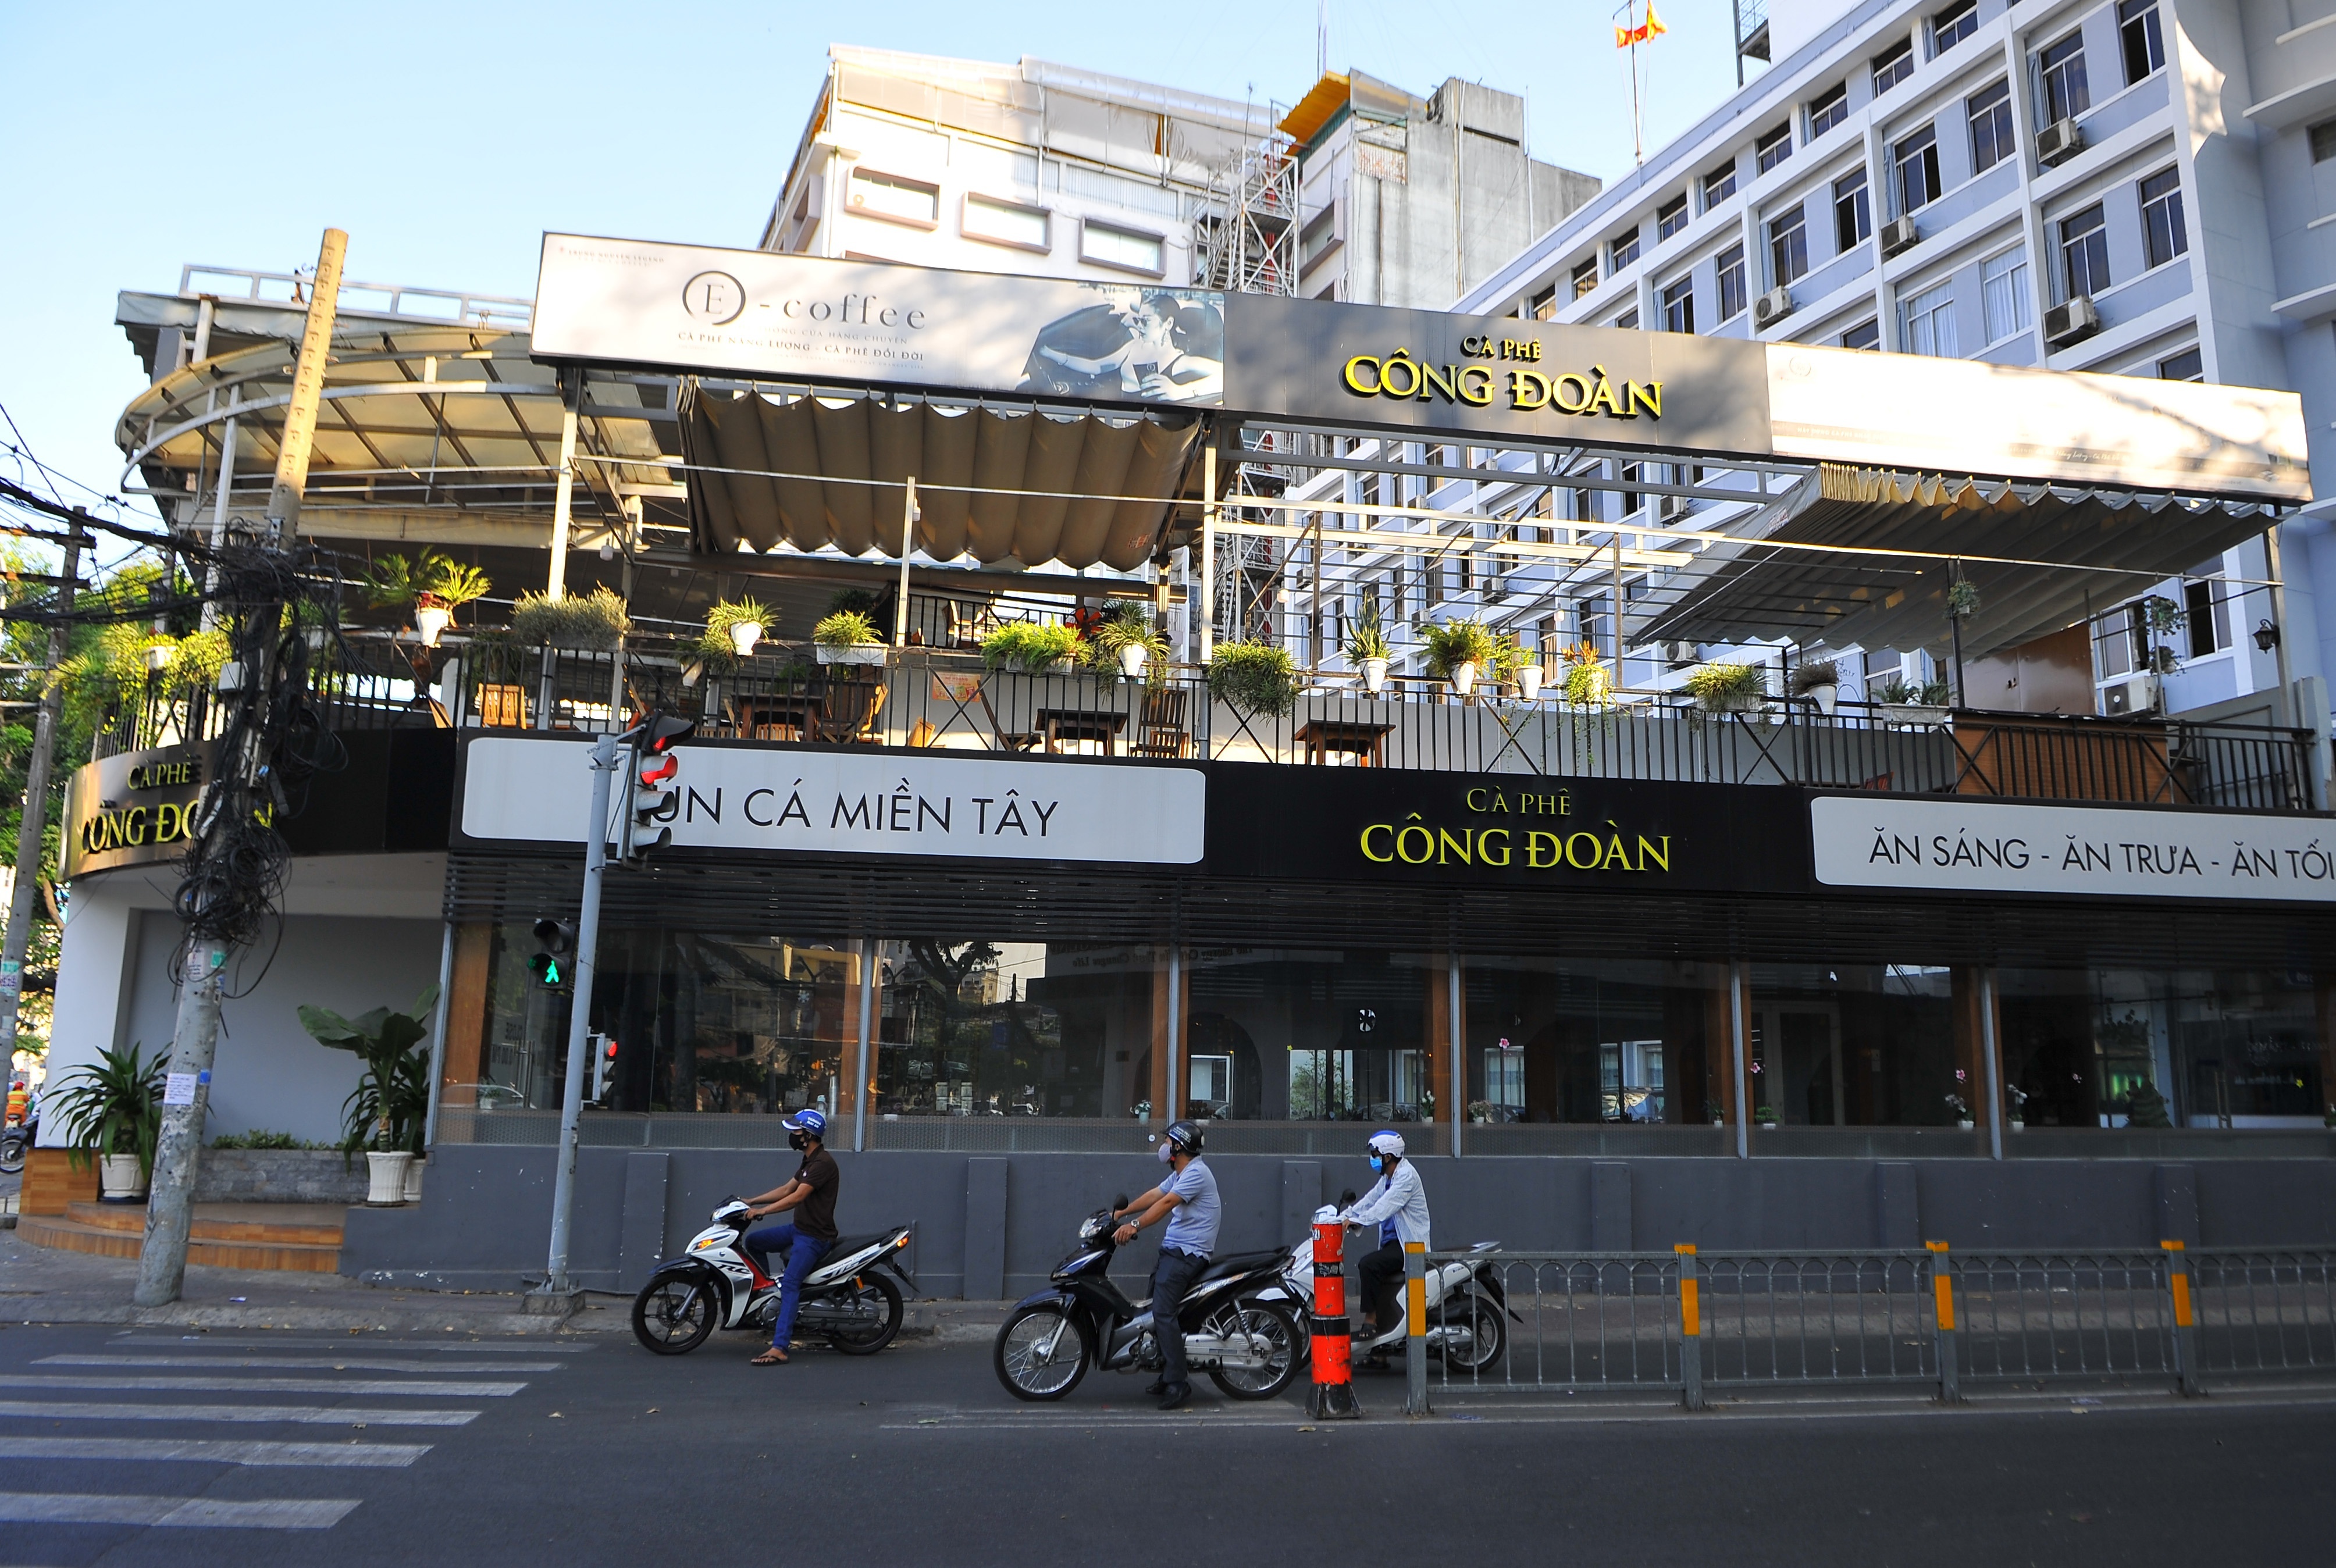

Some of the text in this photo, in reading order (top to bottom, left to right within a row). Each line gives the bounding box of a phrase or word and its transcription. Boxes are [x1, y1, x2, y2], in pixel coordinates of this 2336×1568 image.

[783, 293, 925, 330] coffee
[825, 343, 840, 354] CÀ
[846, 345, 868, 357] PHÊ
[1463, 334, 1543, 360] CÀ PHÊ
[1344, 346, 1663, 418] CÔNG ĐOÀN
[744, 778, 811, 828] CÁ
[830, 776, 951, 834] MIỀN
[971, 788, 1059, 837] TÂY
[1466, 785, 1571, 816] CÀ PHÊ
[1360, 812, 1671, 872] CÔNG ĐOÀN
[1869, 826, 1920, 865] ĂN
[1933, 827, 2030, 869] SÁNG
[2062, 835, 2112, 872] ĂN
[2120, 843, 2202, 876] TRƯA
[2231, 842, 2278, 879] ĂN
[2284, 838, 2335, 881] TỐI
